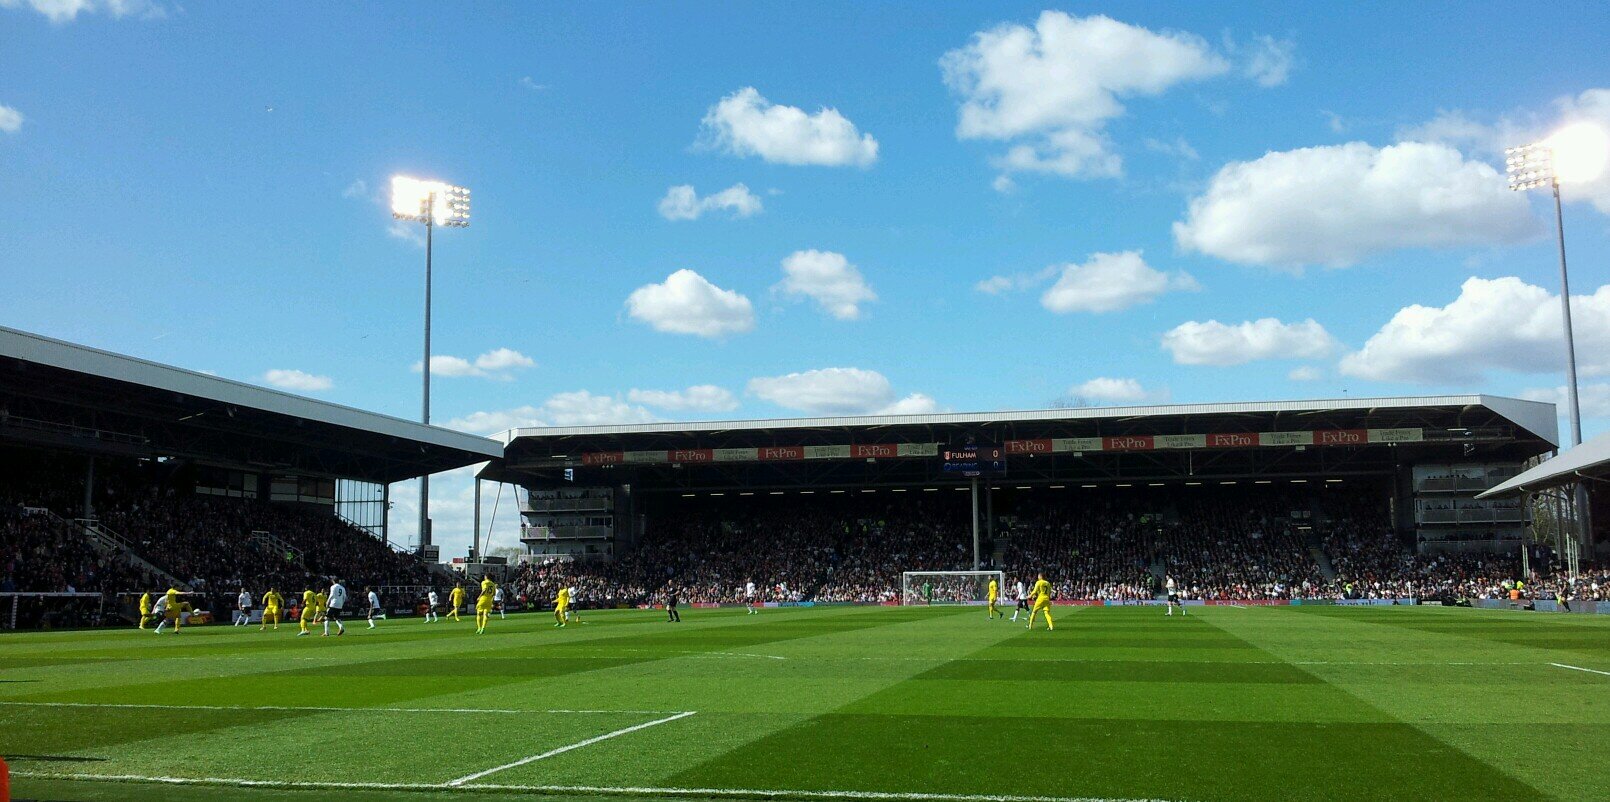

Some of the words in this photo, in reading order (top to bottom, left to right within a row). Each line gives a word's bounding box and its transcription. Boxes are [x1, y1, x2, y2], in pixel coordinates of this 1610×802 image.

[1215, 434, 1251, 445] FxPro
[1322, 431, 1359, 442] FxPro
[1011, 441, 1045, 452] FxPro
[1111, 438, 1146, 449] FxPro
[675, 451, 706, 461] FxPro
[765, 448, 797, 459] FxPro
[858, 446, 890, 456] FxPro
[992, 450, 999, 458] 0
[338, 588, 343, 596] 9
